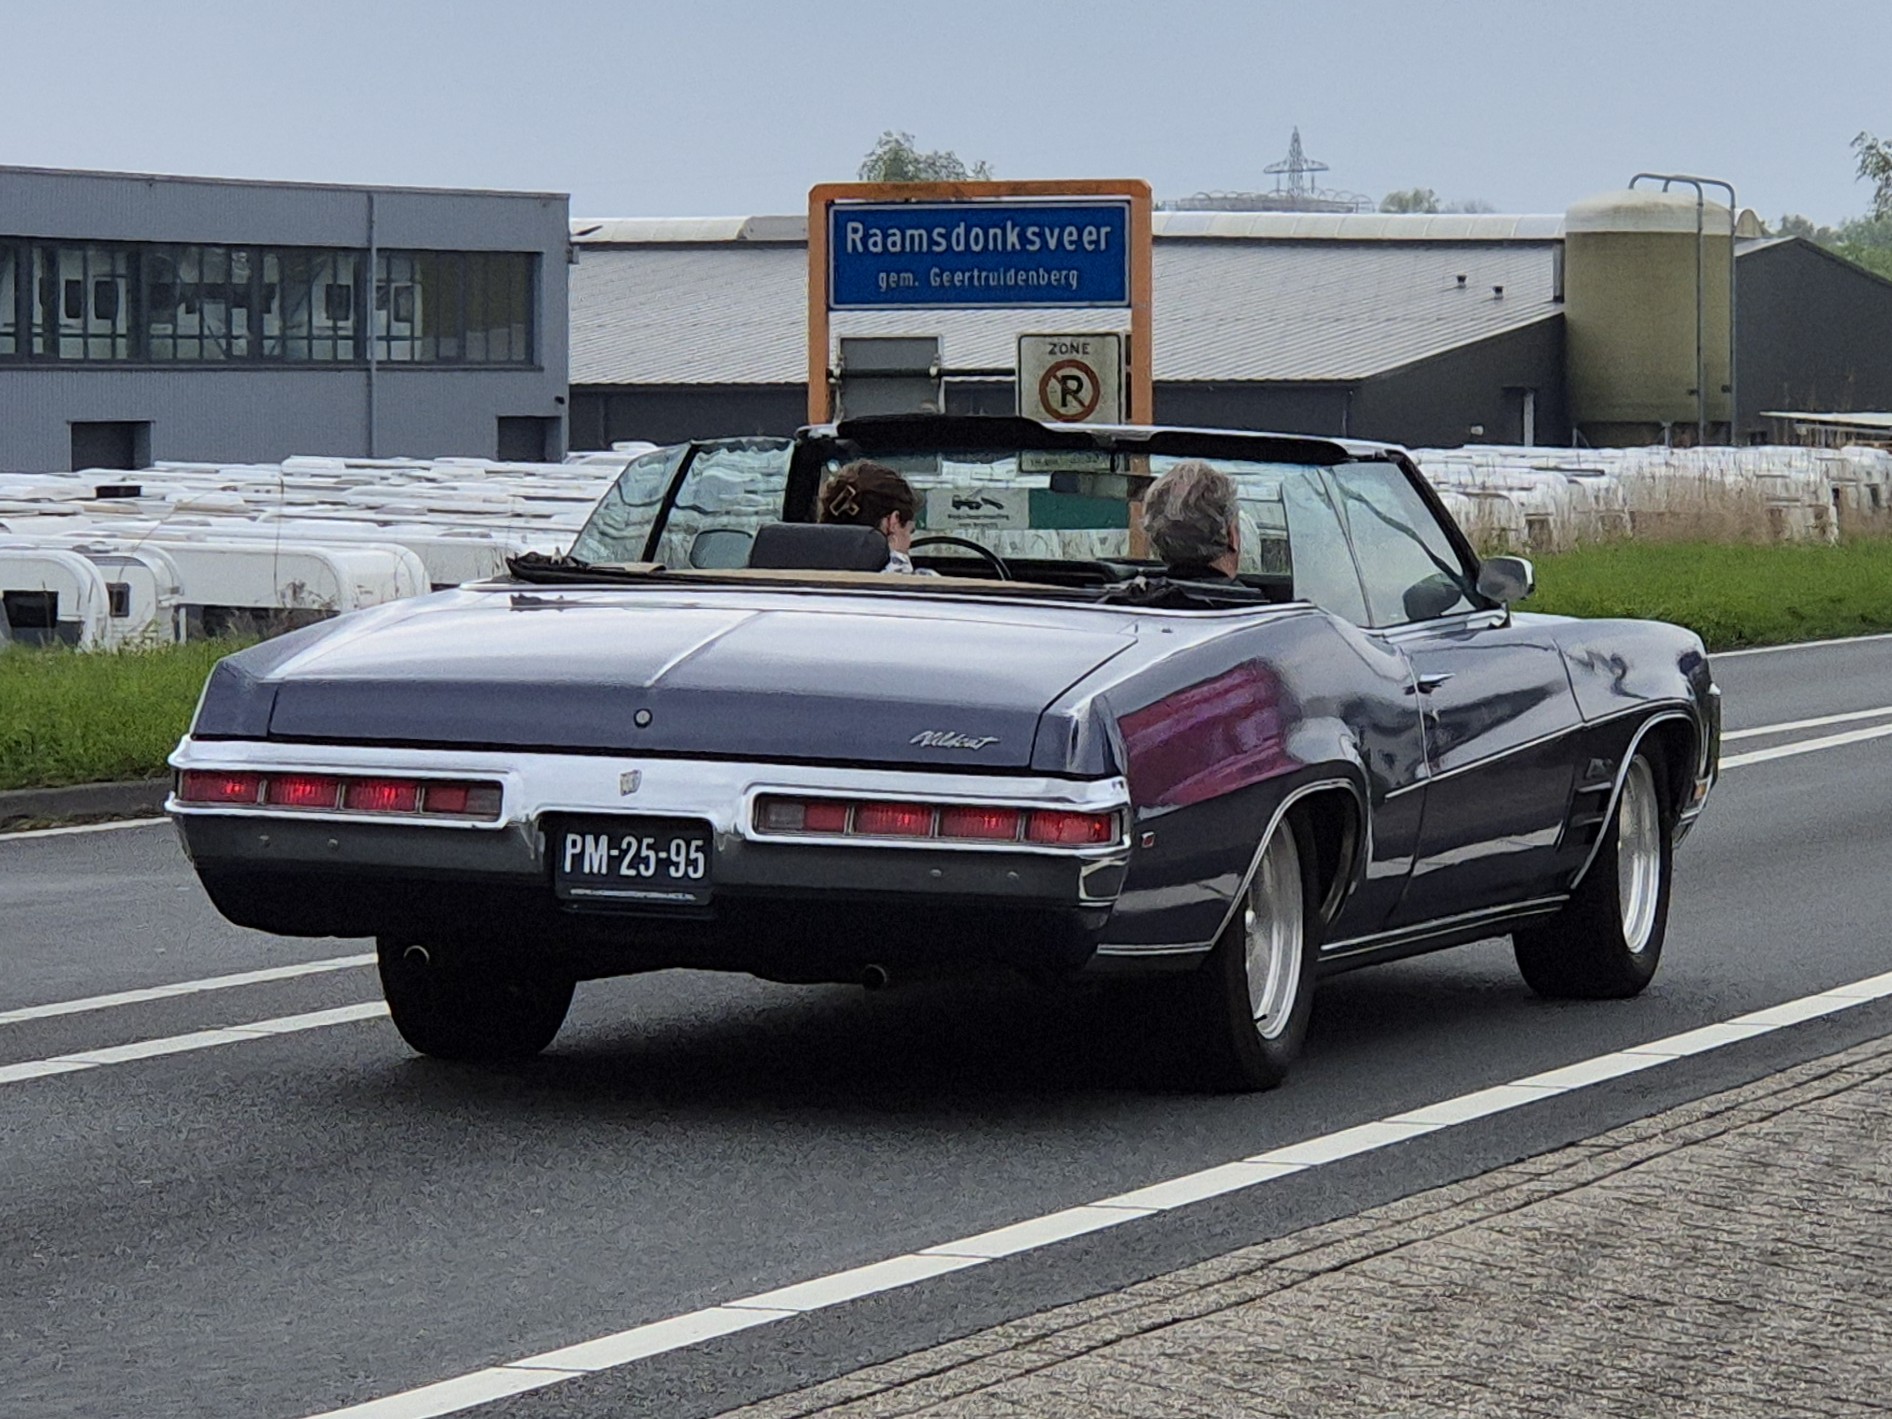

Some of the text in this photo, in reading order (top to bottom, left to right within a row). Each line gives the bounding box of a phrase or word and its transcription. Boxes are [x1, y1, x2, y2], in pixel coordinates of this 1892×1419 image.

[846, 220, 1112, 254] Raamsdonksveer
[878, 267, 1079, 292] gem. Geertruidenberg
[1047, 342, 1090, 356] ZONE
[564, 833, 705, 880] PM-25-95
